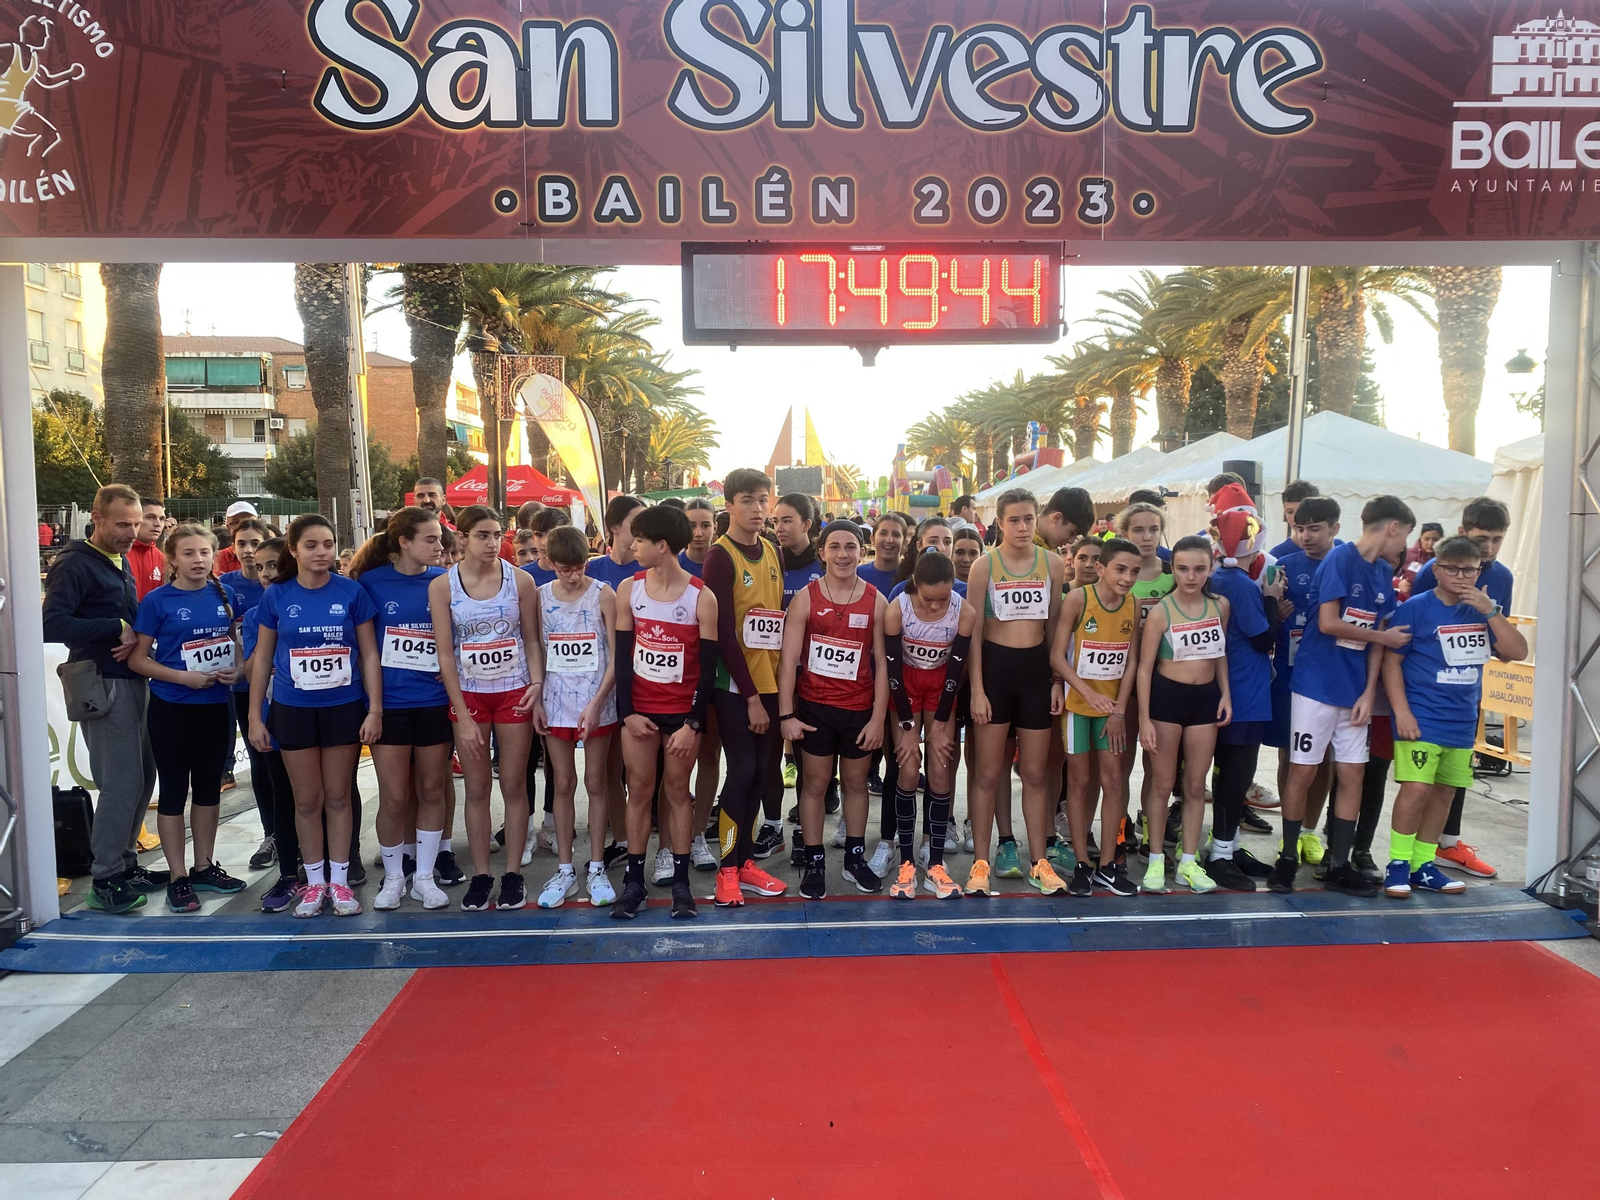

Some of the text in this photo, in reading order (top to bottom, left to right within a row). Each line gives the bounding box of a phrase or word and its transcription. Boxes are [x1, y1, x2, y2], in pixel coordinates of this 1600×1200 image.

[309, 0, 1322, 132] San Silvestre
[541, 170, 1111, 223] BAILÉN 2023
[776, 253, 1042, 330] 17:49:44
[1001, 590, 1043, 604] 1003
[298, 625, 344, 634] SAN SILVESTRE
[748, 618, 781, 634] 1032
[391, 638, 437, 655] 1045
[1180, 629, 1220, 647] 1038
[1447, 634, 1486, 649] 1055
[193, 643, 231, 663] 1044
[468, 649, 513, 665] 1005
[552, 642, 593, 656] 1002
[815, 645, 856, 664] 1054
[298, 656, 343, 673] 1051
[638, 648, 678, 668] 1028
[1087, 651, 1124, 665] 1029
[1489, 669, 1533, 684] AYUNTAMIENTO
[1505, 682, 1515, 691] DE
[1489, 690, 1533, 707] JABALQUINTO
[1294, 731, 1313, 753] 16
